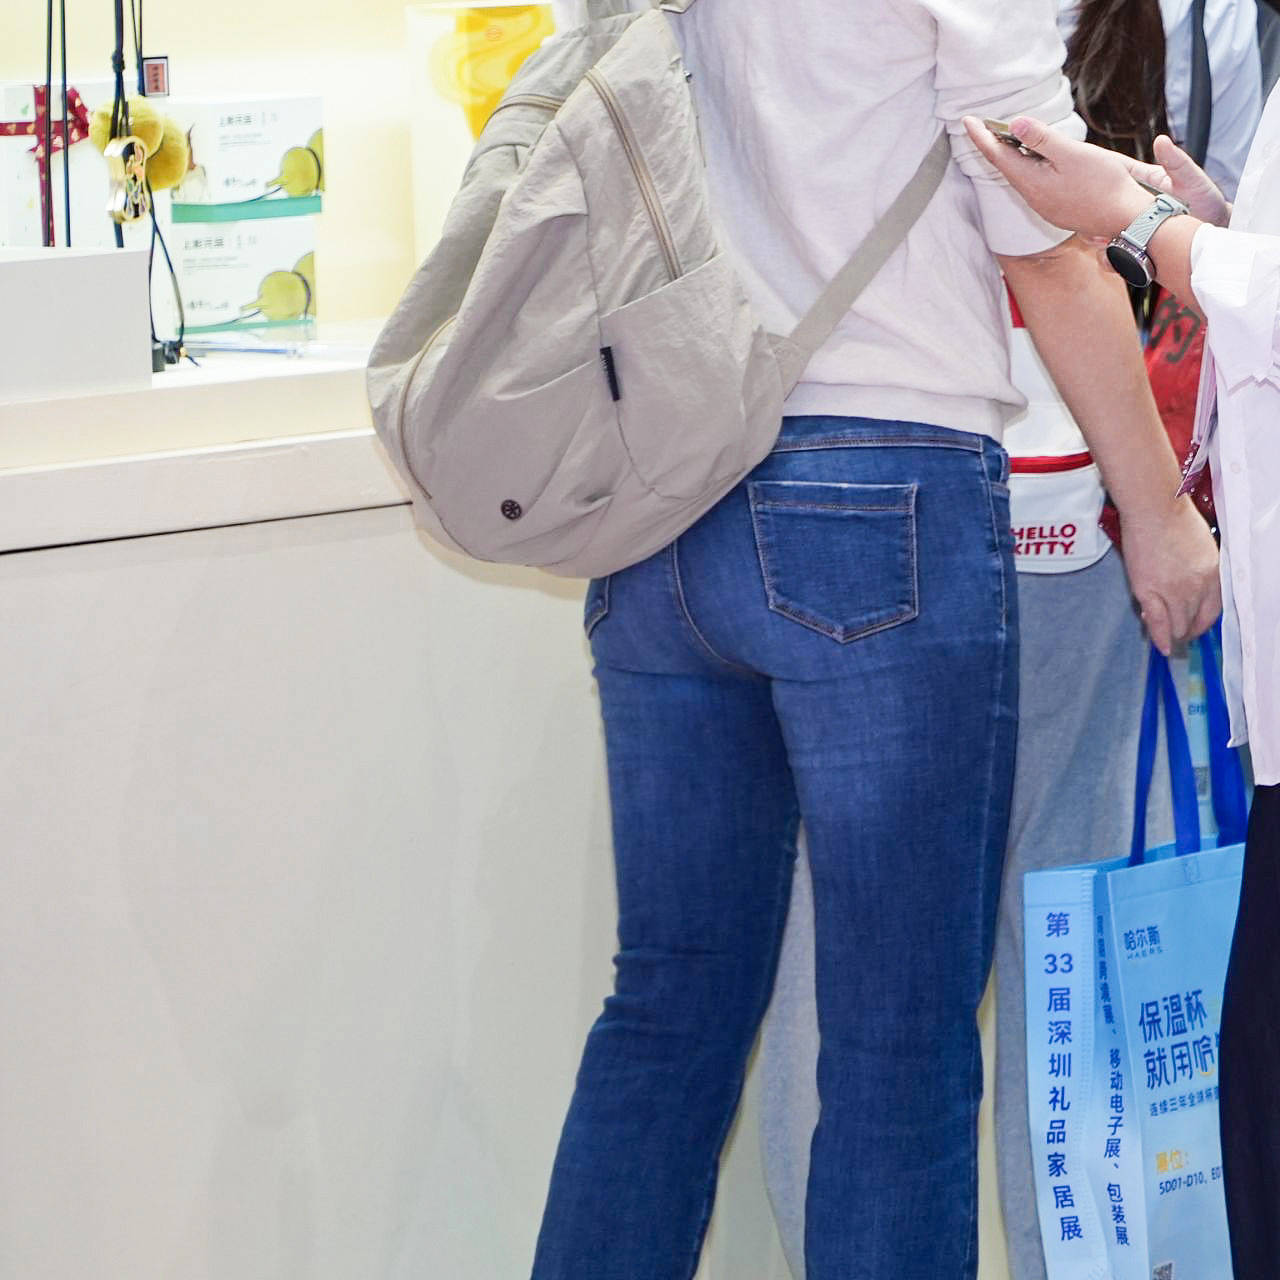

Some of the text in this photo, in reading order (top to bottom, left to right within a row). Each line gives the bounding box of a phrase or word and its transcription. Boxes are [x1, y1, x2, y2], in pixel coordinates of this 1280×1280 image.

[1009, 524, 1076, 540] HELLO
[1139, 989, 1207, 1043] 保温杯
[1043, 912, 1083, 1241] 第33届深圳礼品家居展
